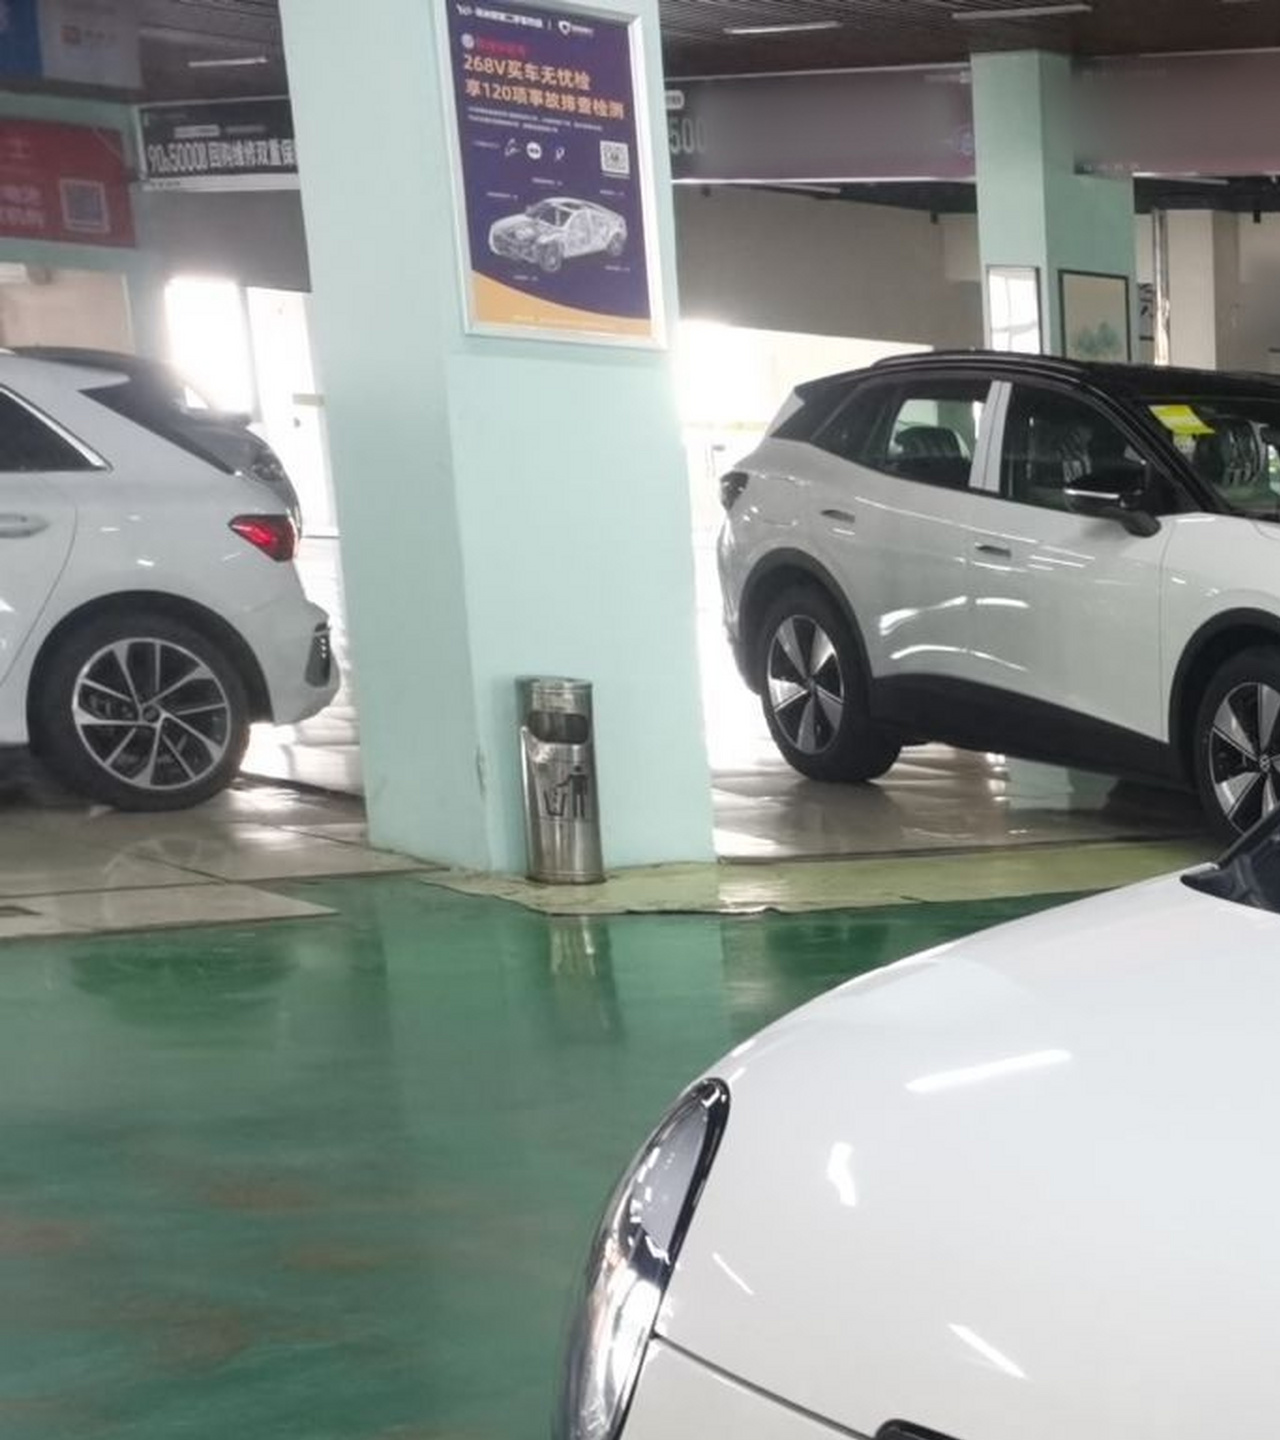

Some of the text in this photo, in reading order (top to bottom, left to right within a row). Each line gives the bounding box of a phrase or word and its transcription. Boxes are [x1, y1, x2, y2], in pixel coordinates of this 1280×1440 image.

[463, 55, 591, 91] 268V买车无忧检
